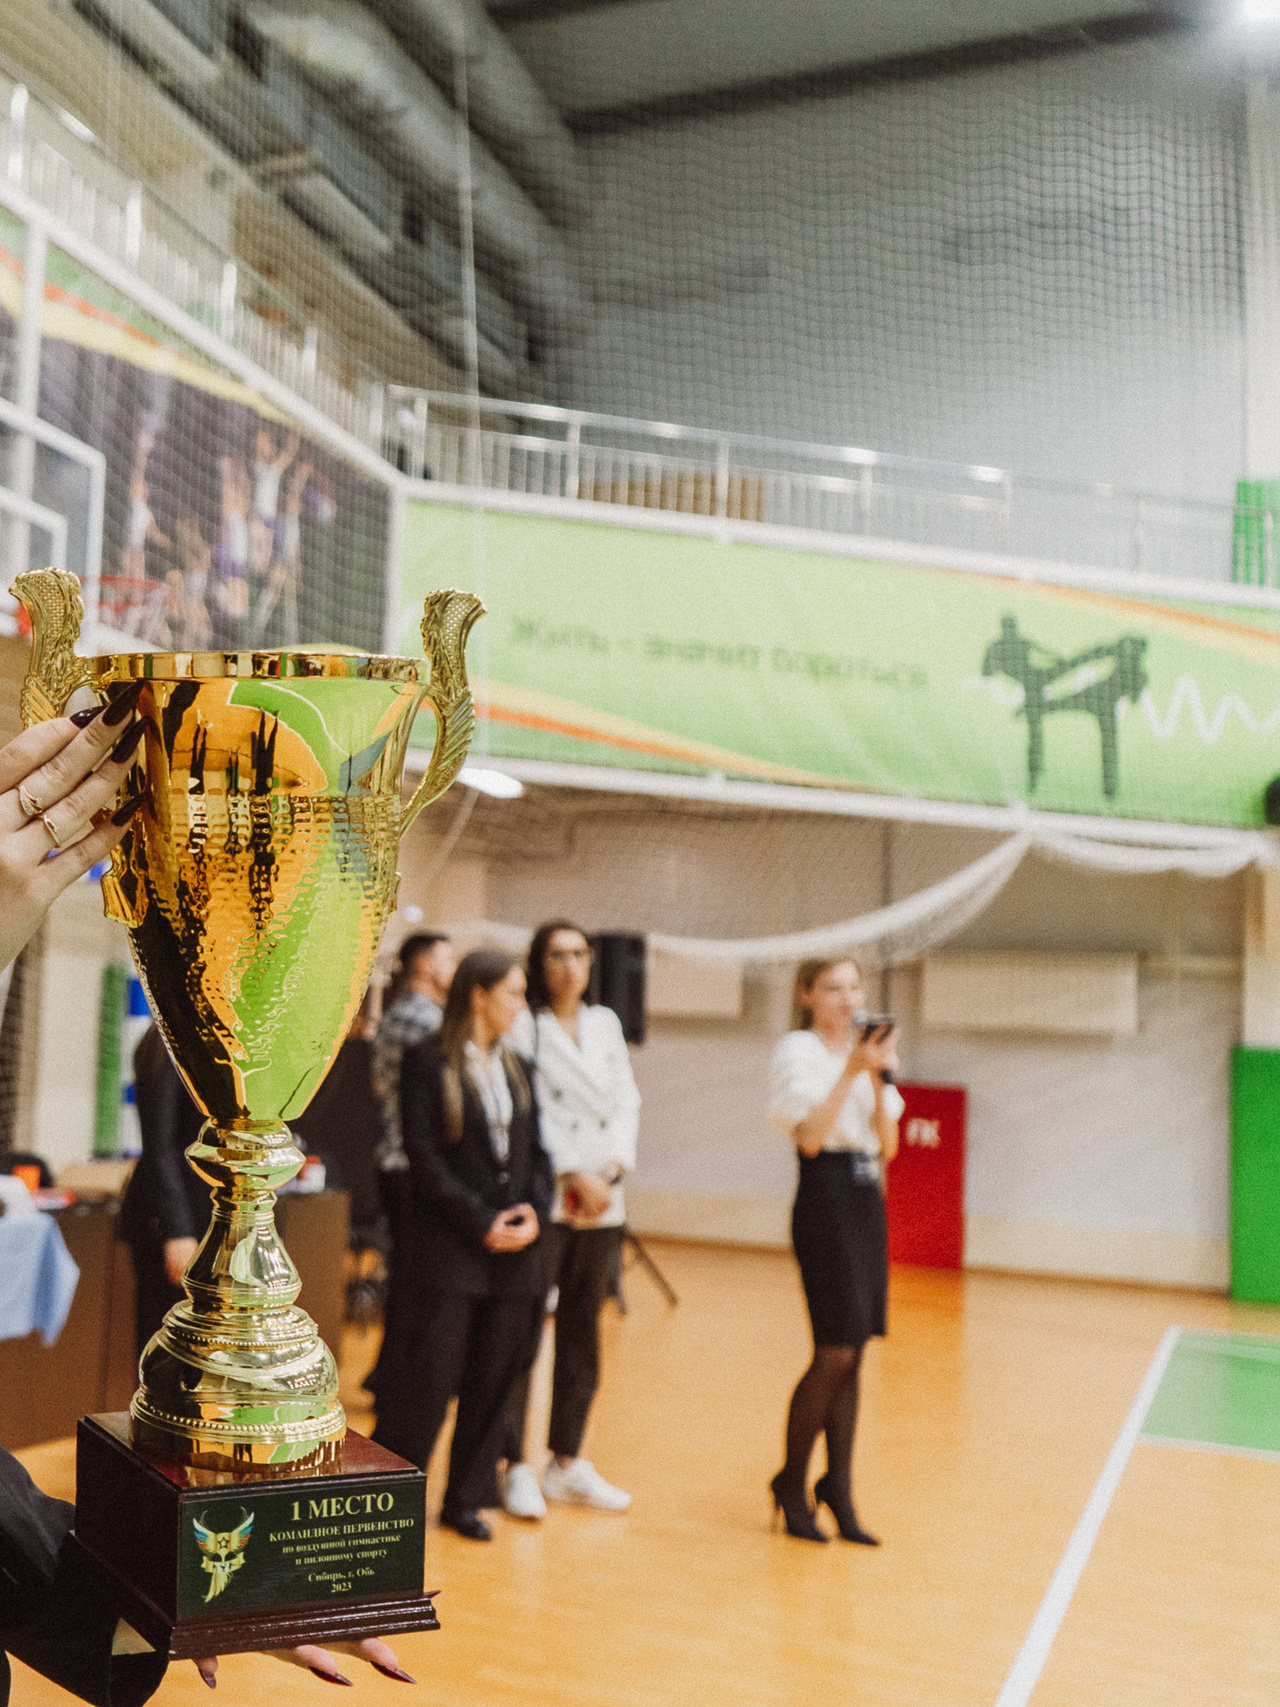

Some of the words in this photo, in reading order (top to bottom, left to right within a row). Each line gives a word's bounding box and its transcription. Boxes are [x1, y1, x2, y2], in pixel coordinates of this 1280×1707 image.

[291, 1501, 302, 1521] 1
[308, 1492, 394, 1520] МЕСТО
[270, 1525, 341, 1542] КОМАНДНОЕ
[343, 1518, 415, 1535] ПЕРВЕНСТВО
[282, 1545, 294, 1554] по
[296, 1538, 346, 1553] воздушной
[348, 1534, 401, 1547] гимнастике
[304, 1552, 354, 1565] пилонному
[356, 1549, 387, 1561] спорту
[356, 1567, 375, 1577] Обь
[331, 1582, 352, 1593] 2023
